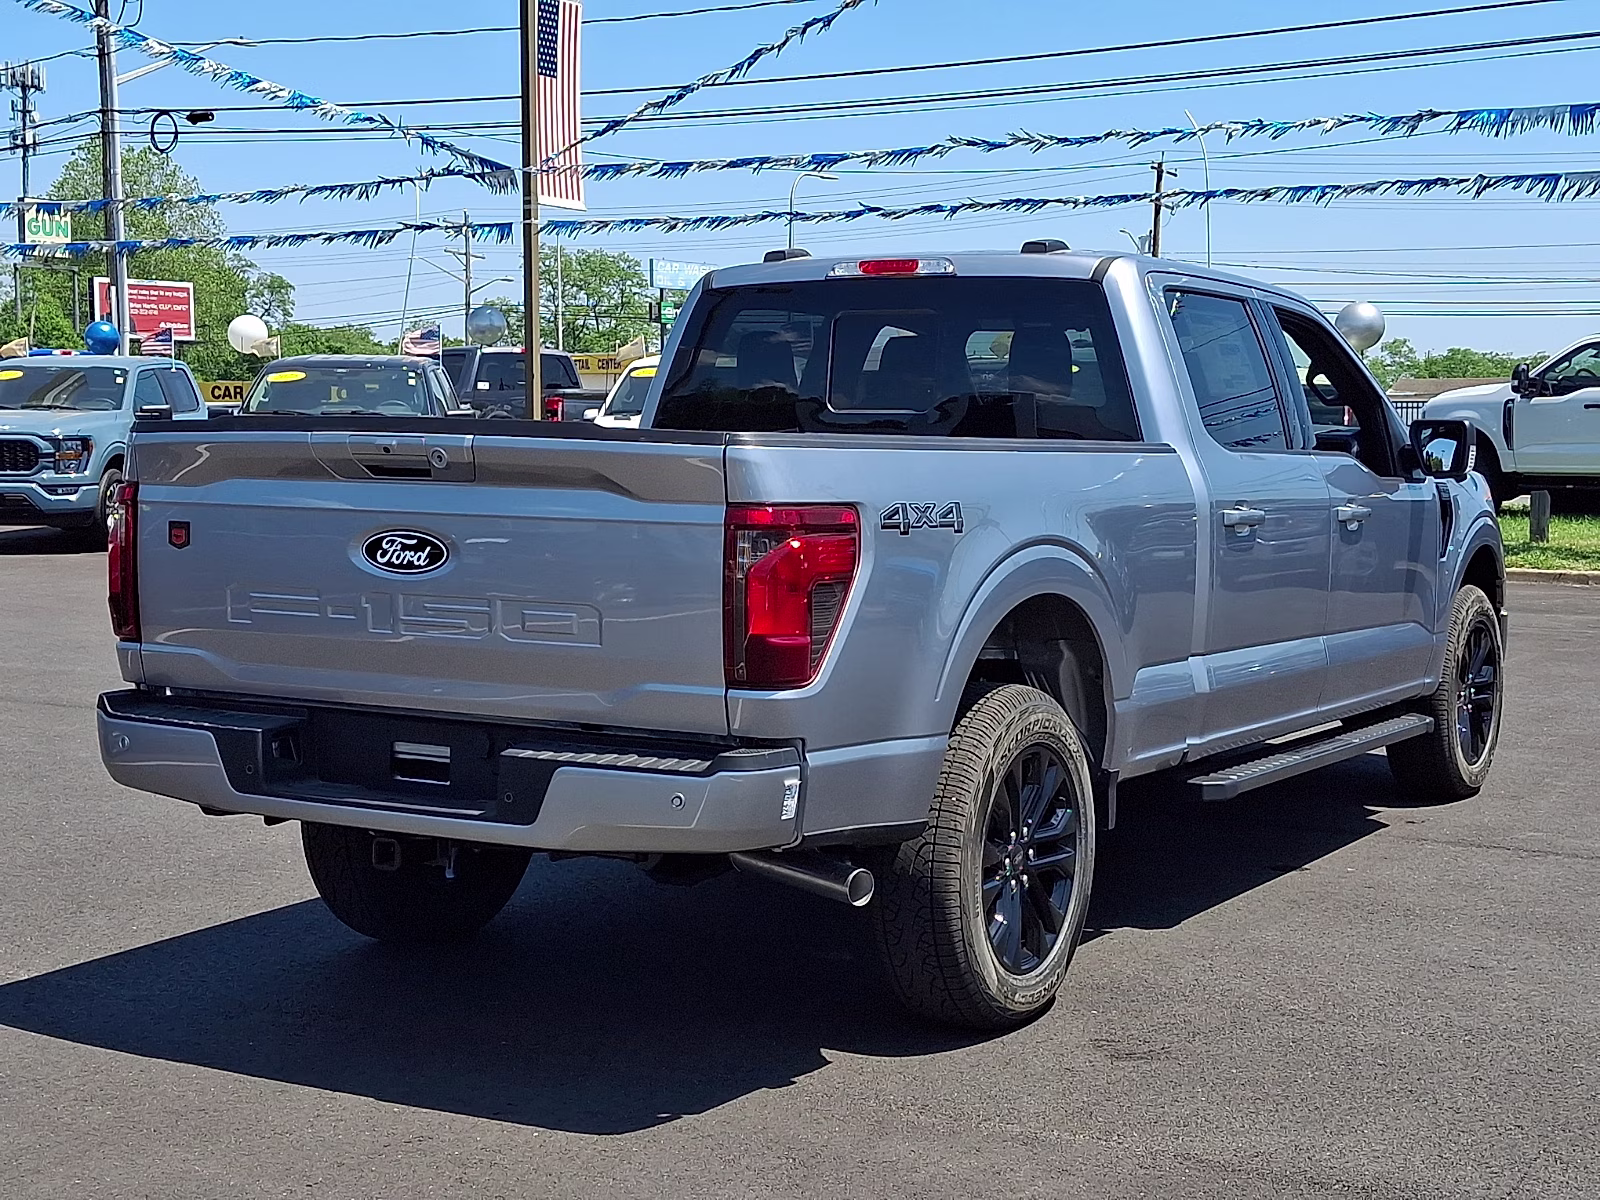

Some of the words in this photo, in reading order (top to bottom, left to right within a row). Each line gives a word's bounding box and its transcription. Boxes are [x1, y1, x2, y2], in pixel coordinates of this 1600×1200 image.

[27, 217, 69, 239] GUN
[657, 261, 680, 275] CAR
[597, 358, 622, 371] CENTER
[210, 385, 244, 400] CAR
[376, 536, 432, 566] Ford
[225, 582, 603, 649] F-150
